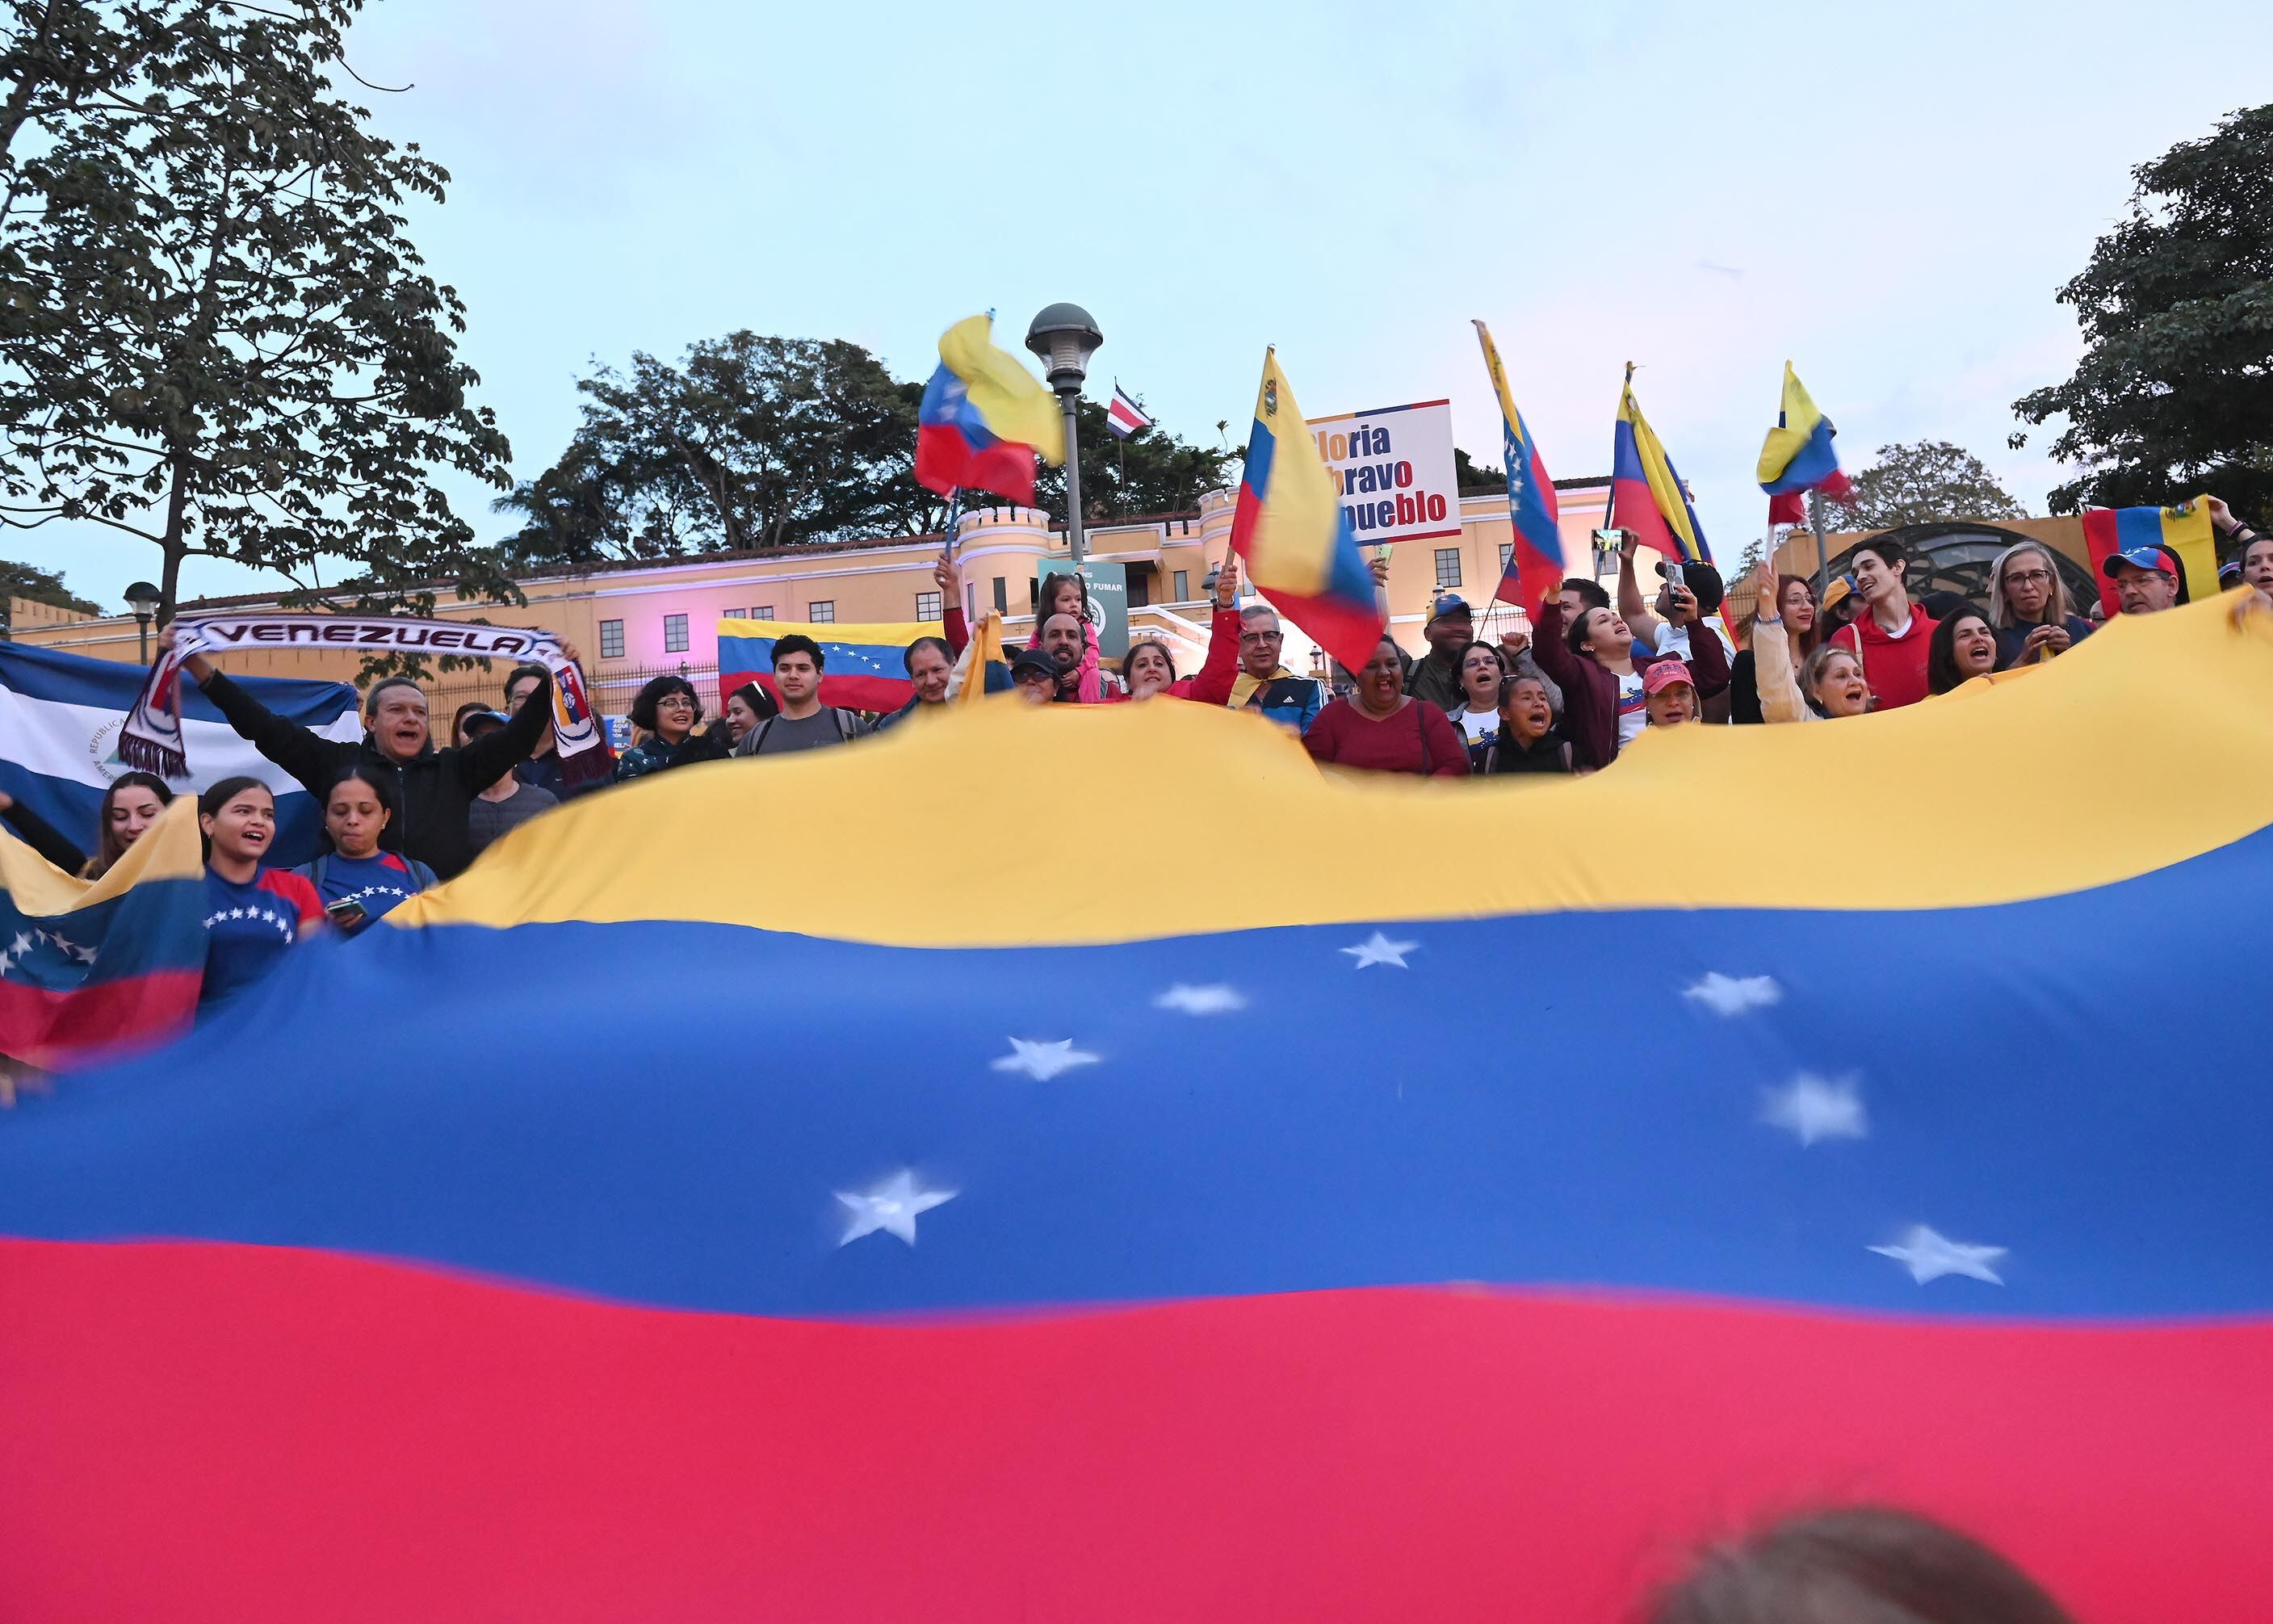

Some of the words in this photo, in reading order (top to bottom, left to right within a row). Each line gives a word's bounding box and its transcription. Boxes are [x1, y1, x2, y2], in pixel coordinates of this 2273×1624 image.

[1311, 424, 1391, 463] loria
[1093, 582, 1122, 591] FUMAR
[208, 624, 526, 653] VENEZUELA
[90, 718, 126, 754] REPUBLICA
